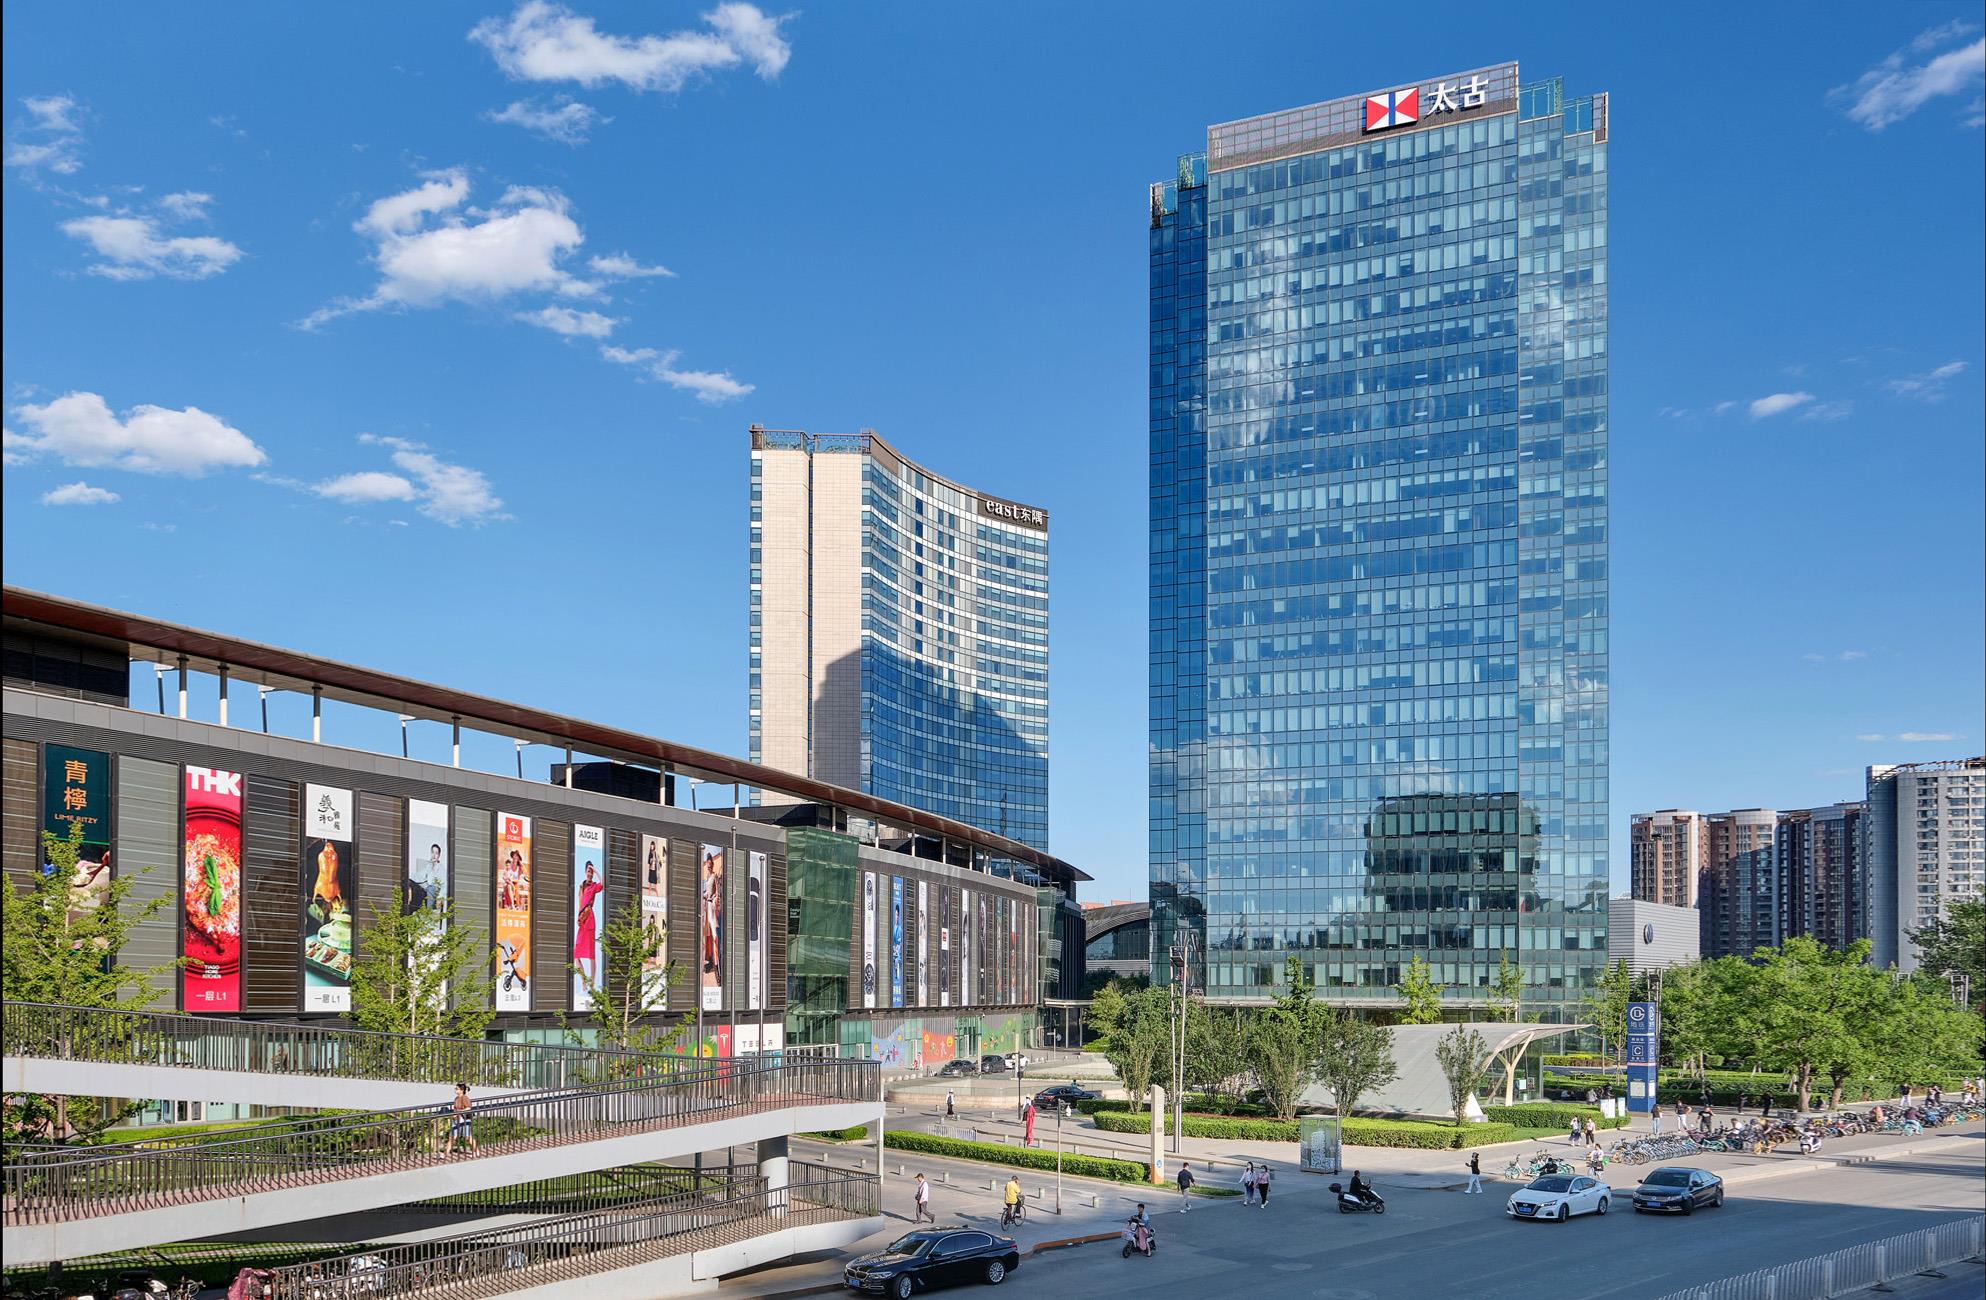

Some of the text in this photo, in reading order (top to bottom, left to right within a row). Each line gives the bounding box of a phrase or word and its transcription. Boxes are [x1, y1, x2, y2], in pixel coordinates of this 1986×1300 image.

[1424, 75, 1489, 120] 太古
[986, 500, 1020, 519] east
[64, 760, 88, 810] 青檸
[186, 765, 242, 797] THK
[579, 829, 599, 840] AIGLE
[216, 992, 227, 1001] L1
[331, 995, 340, 1003] L1
[1634, 1046, 1642, 1055] C
